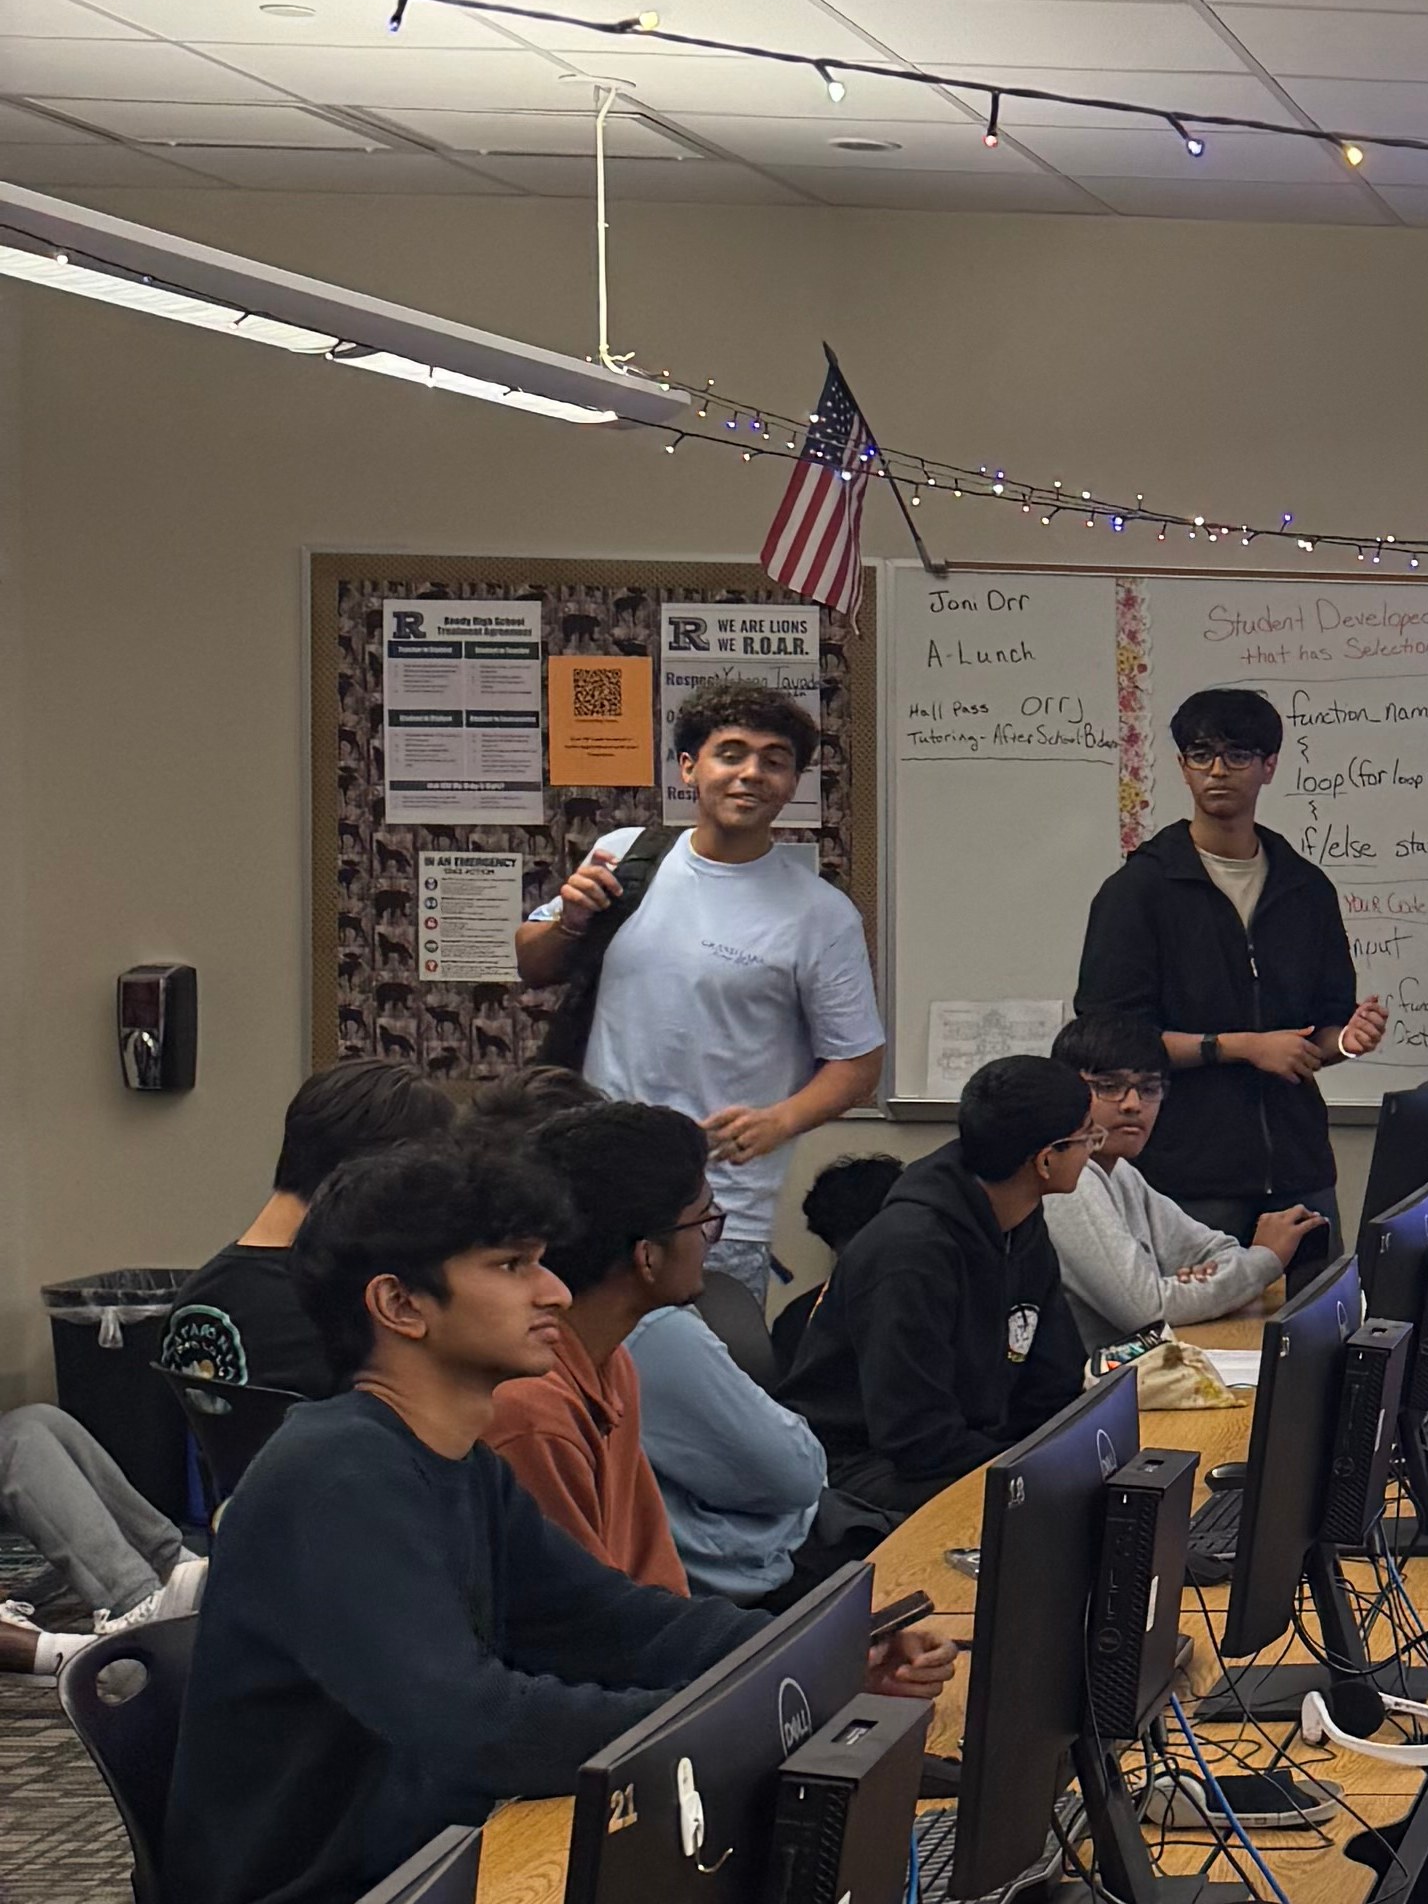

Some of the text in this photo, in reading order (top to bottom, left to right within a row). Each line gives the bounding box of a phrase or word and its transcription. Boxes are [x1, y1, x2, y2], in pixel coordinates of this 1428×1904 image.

[928, 589, 1031, 613] Joni Orr
[717, 619, 808, 634] WE ARE LIONS
[1203, 604, 1304, 642] Student
[718, 636, 810, 656] WE R.O.A.R.
[1240, 646, 1291, 665] that
[1299, 645, 1333, 662] has
[909, 703, 943, 721] Hall
[952, 701, 989, 717] Pass
[993, 723, 1034, 745] After
[1296, 766, 1346, 798] loop
[1351, 926, 1413, 968] nput
[784, 1708, 811, 1746] DELL
[607, 1783, 638, 1835] 21
